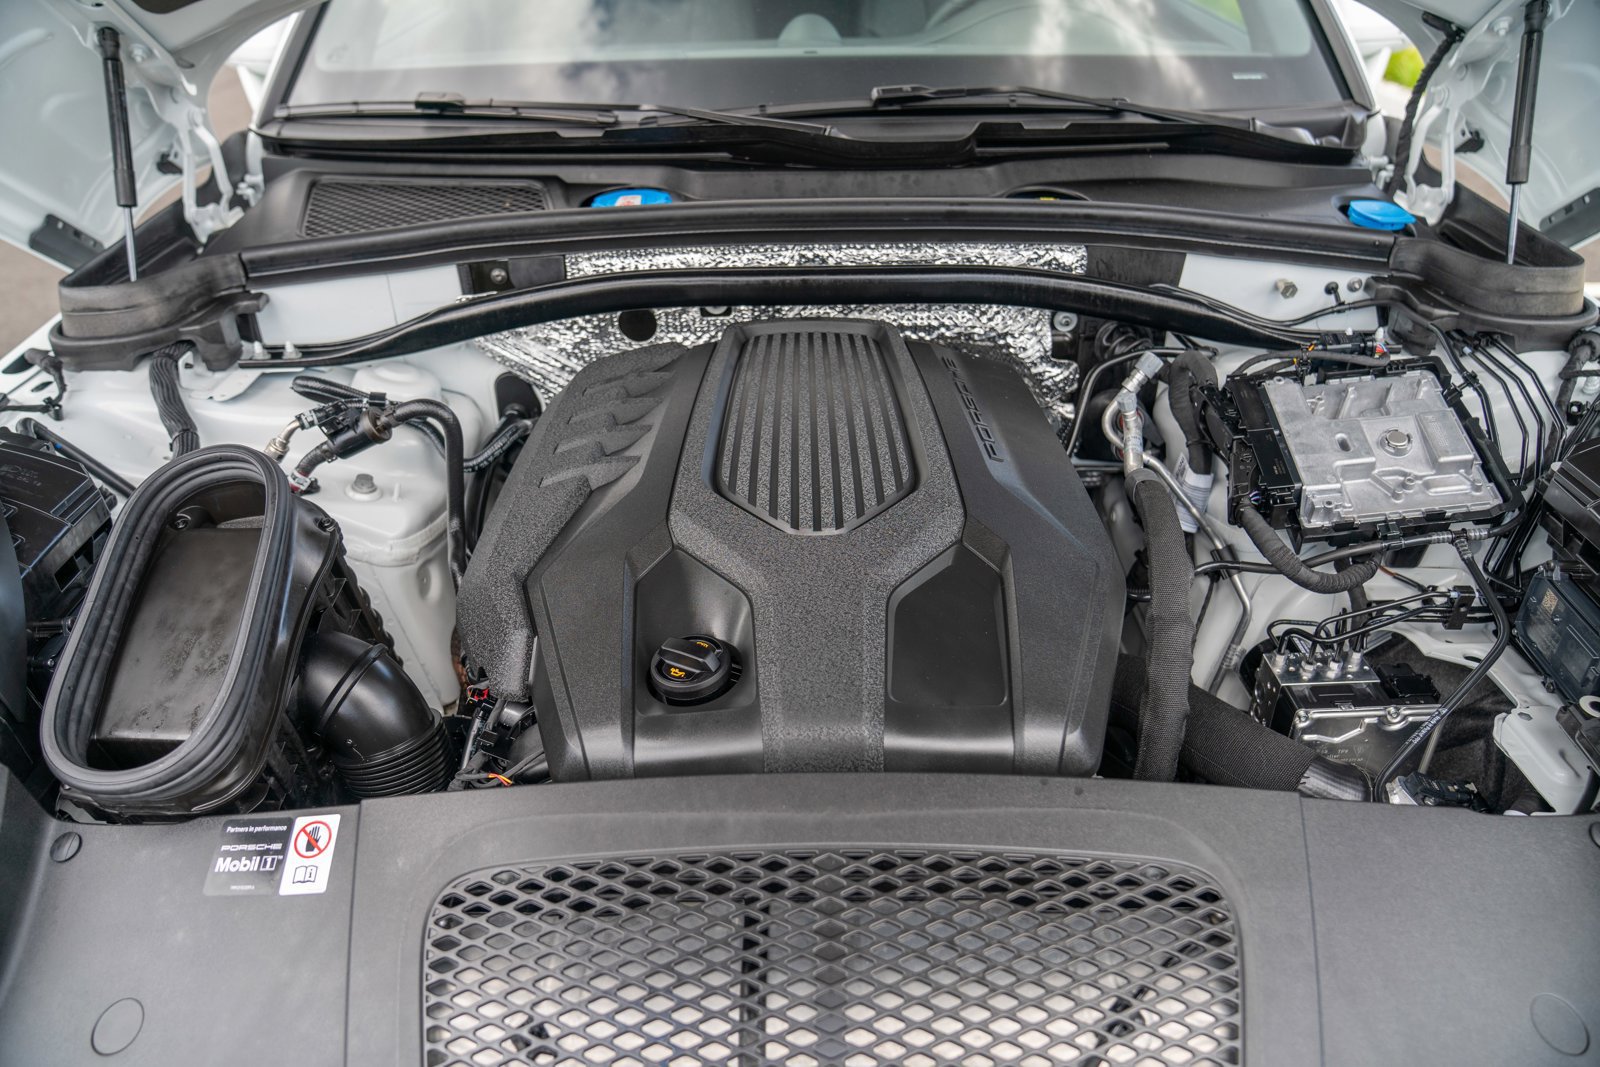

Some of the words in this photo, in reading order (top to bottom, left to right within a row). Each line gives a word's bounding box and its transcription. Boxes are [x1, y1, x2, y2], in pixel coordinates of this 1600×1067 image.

[942, 356, 1004, 463] PORSCHE
[254, 825, 287, 833] performance
[220, 843, 283, 851] PORSCHE
[215, 856, 260, 872] Mobil
